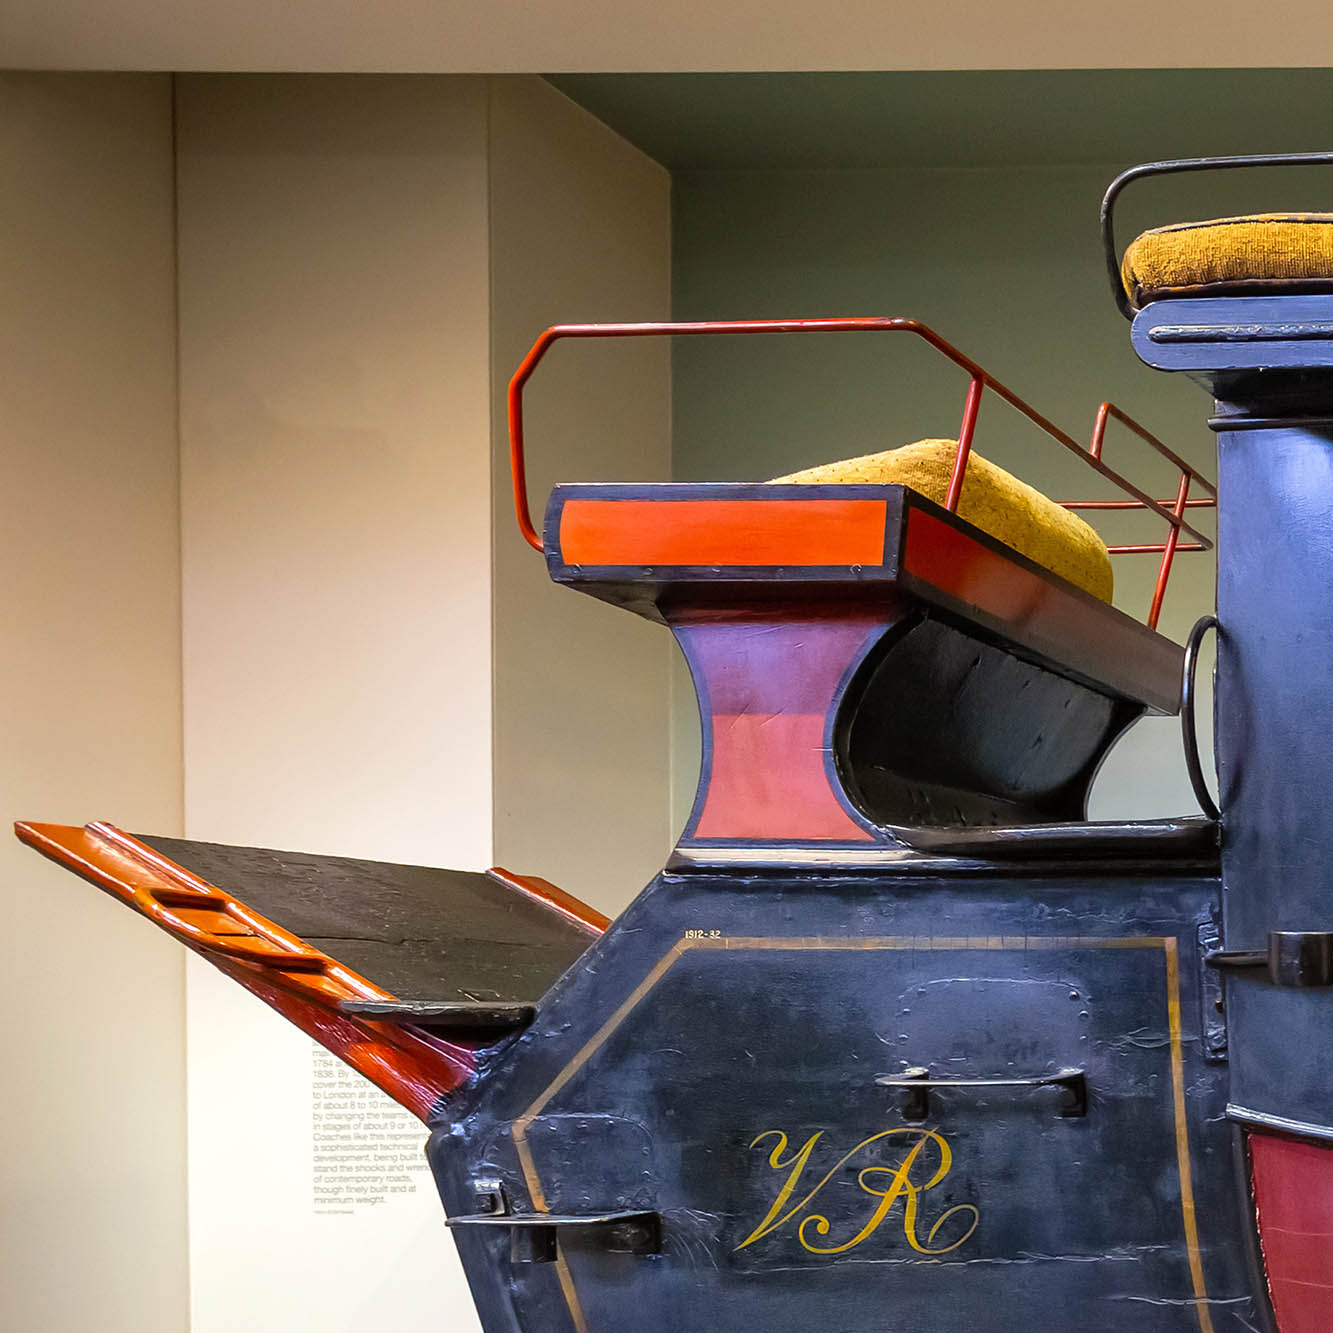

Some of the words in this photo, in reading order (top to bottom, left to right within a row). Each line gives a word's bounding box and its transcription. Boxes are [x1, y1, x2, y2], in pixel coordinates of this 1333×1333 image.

[338, 1080, 352, 1088] the
[313, 1091, 321, 1099] to
[323, 1091, 357, 1099] London
[313, 1101, 321, 1109] of
[323, 1101, 348, 1109] about
[369, 1101, 378, 1109] 10
[313, 1112, 323, 1121] by
[325, 1112, 364, 1121] changing
[366, 1111, 380, 1119] the
[313, 1122, 321, 1130] in
[322, 1123, 350, 1132] stages
[353, 1121, 361, 1130] of
[363, 1121, 389, 1130] about
[390, 1121, 396, 1129] 9
[408, 1121, 419, 1129] 10
[313, 1132, 351, 1141] Coaches
[353, 1132, 368, 1140] like
[370, 1132, 385, 1140] this
[320, 1143, 378, 1152] sophisticated
[380, 1143, 418, 1151] technical
[374, 1153, 398, 1163] being
[400, 1153, 418, 1161] built
[313, 1165, 338, 1173] stand
[339, 1164, 353, 1172] the
[355, 1164, 386, 1172] shocks
[387, 1164, 404, 1172] and
[313, 1175, 322, 1183] of
[324, 1175, 384, 1185] contemporary
[313, 1185, 344, 1196] though
[346, 1185, 368, 1195] finely
[370, 1185, 389, 1193] built
[390, 1185, 407, 1193] and
[313, 1197, 354, 1205] minimum
